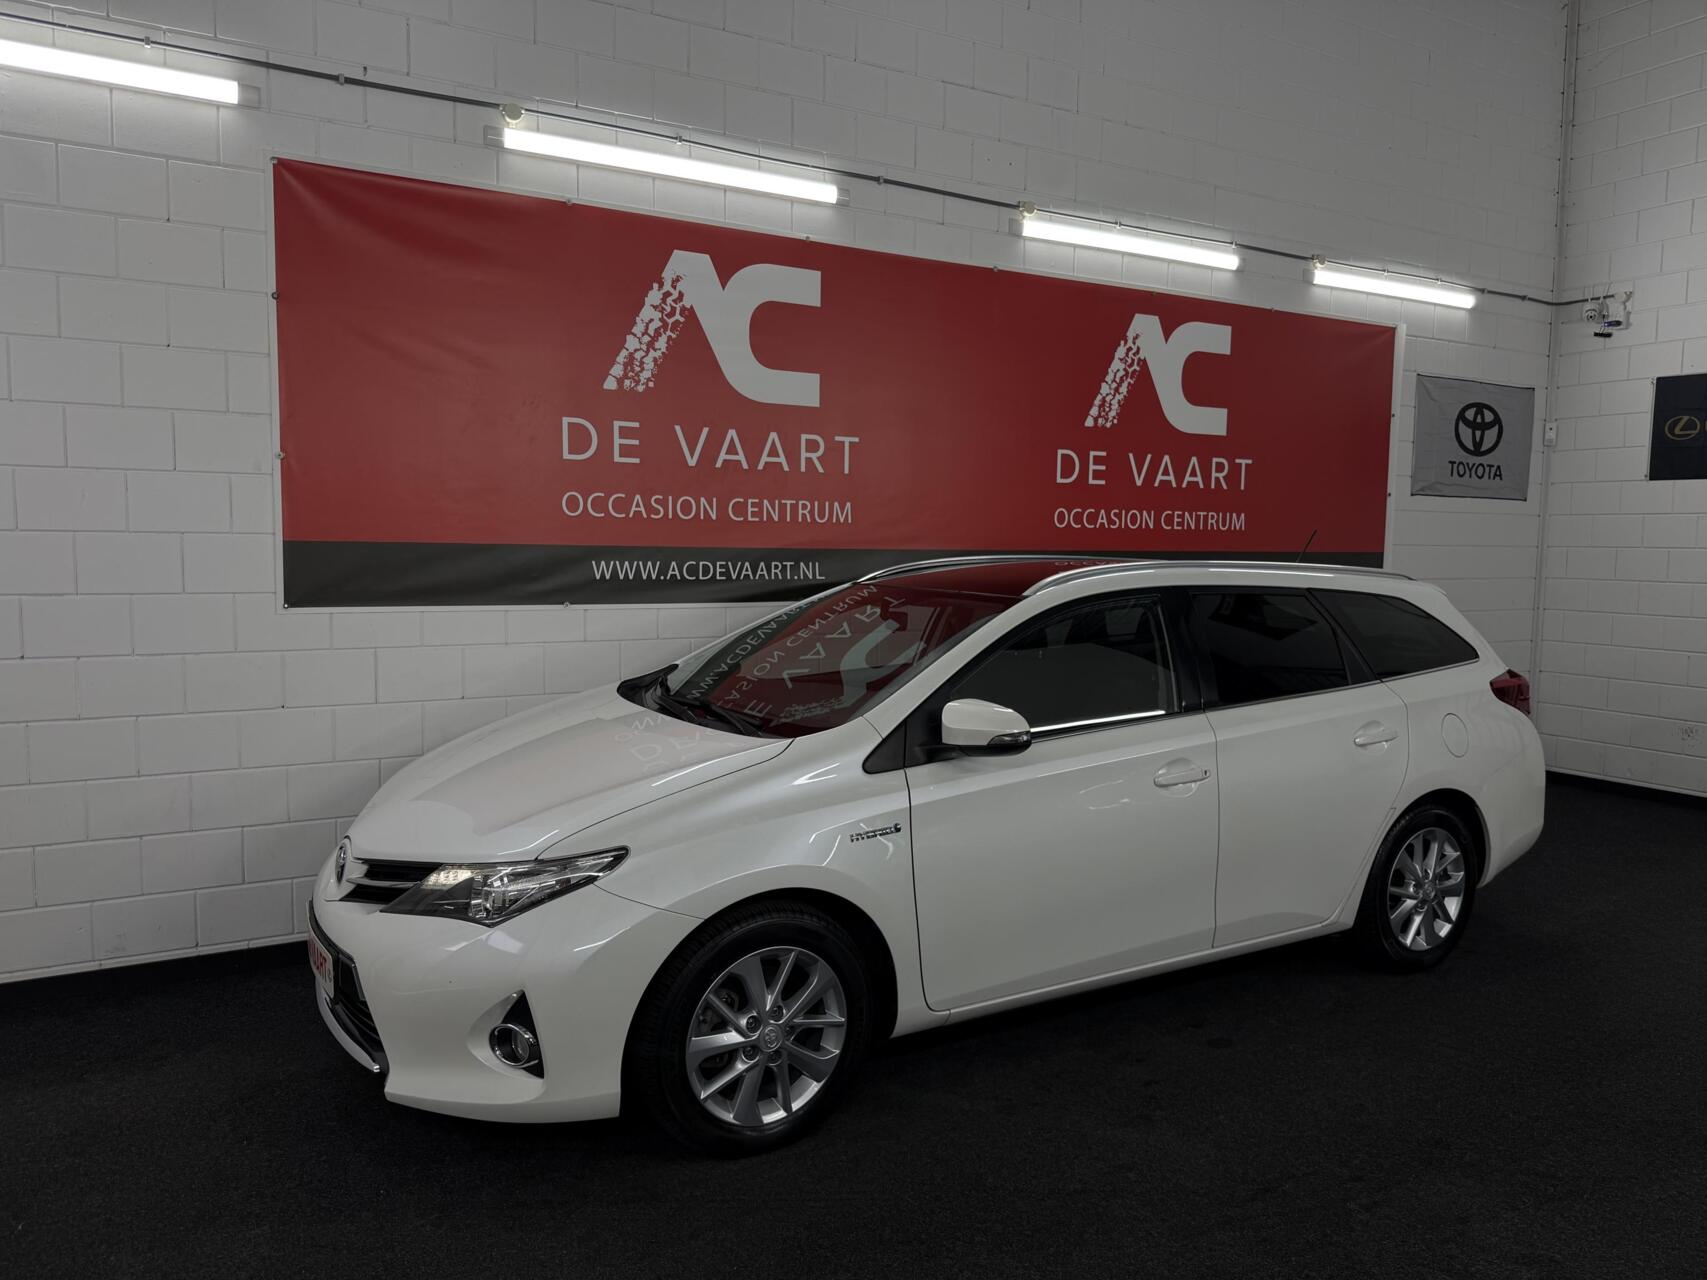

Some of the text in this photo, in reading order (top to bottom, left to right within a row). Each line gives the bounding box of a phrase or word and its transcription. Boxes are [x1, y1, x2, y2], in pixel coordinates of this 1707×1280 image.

[562, 416, 860, 474] DE VAART
[1056, 449, 1252, 490] DE VAART
[1448, 460, 1503, 481] TOYOTA
[561, 491, 852, 524] OCCASION CENTRUM
[1054, 508, 1245, 531] OCCASION CENTRUM
[592, 560, 825, 580] WWW.ACDEVAART.NL
